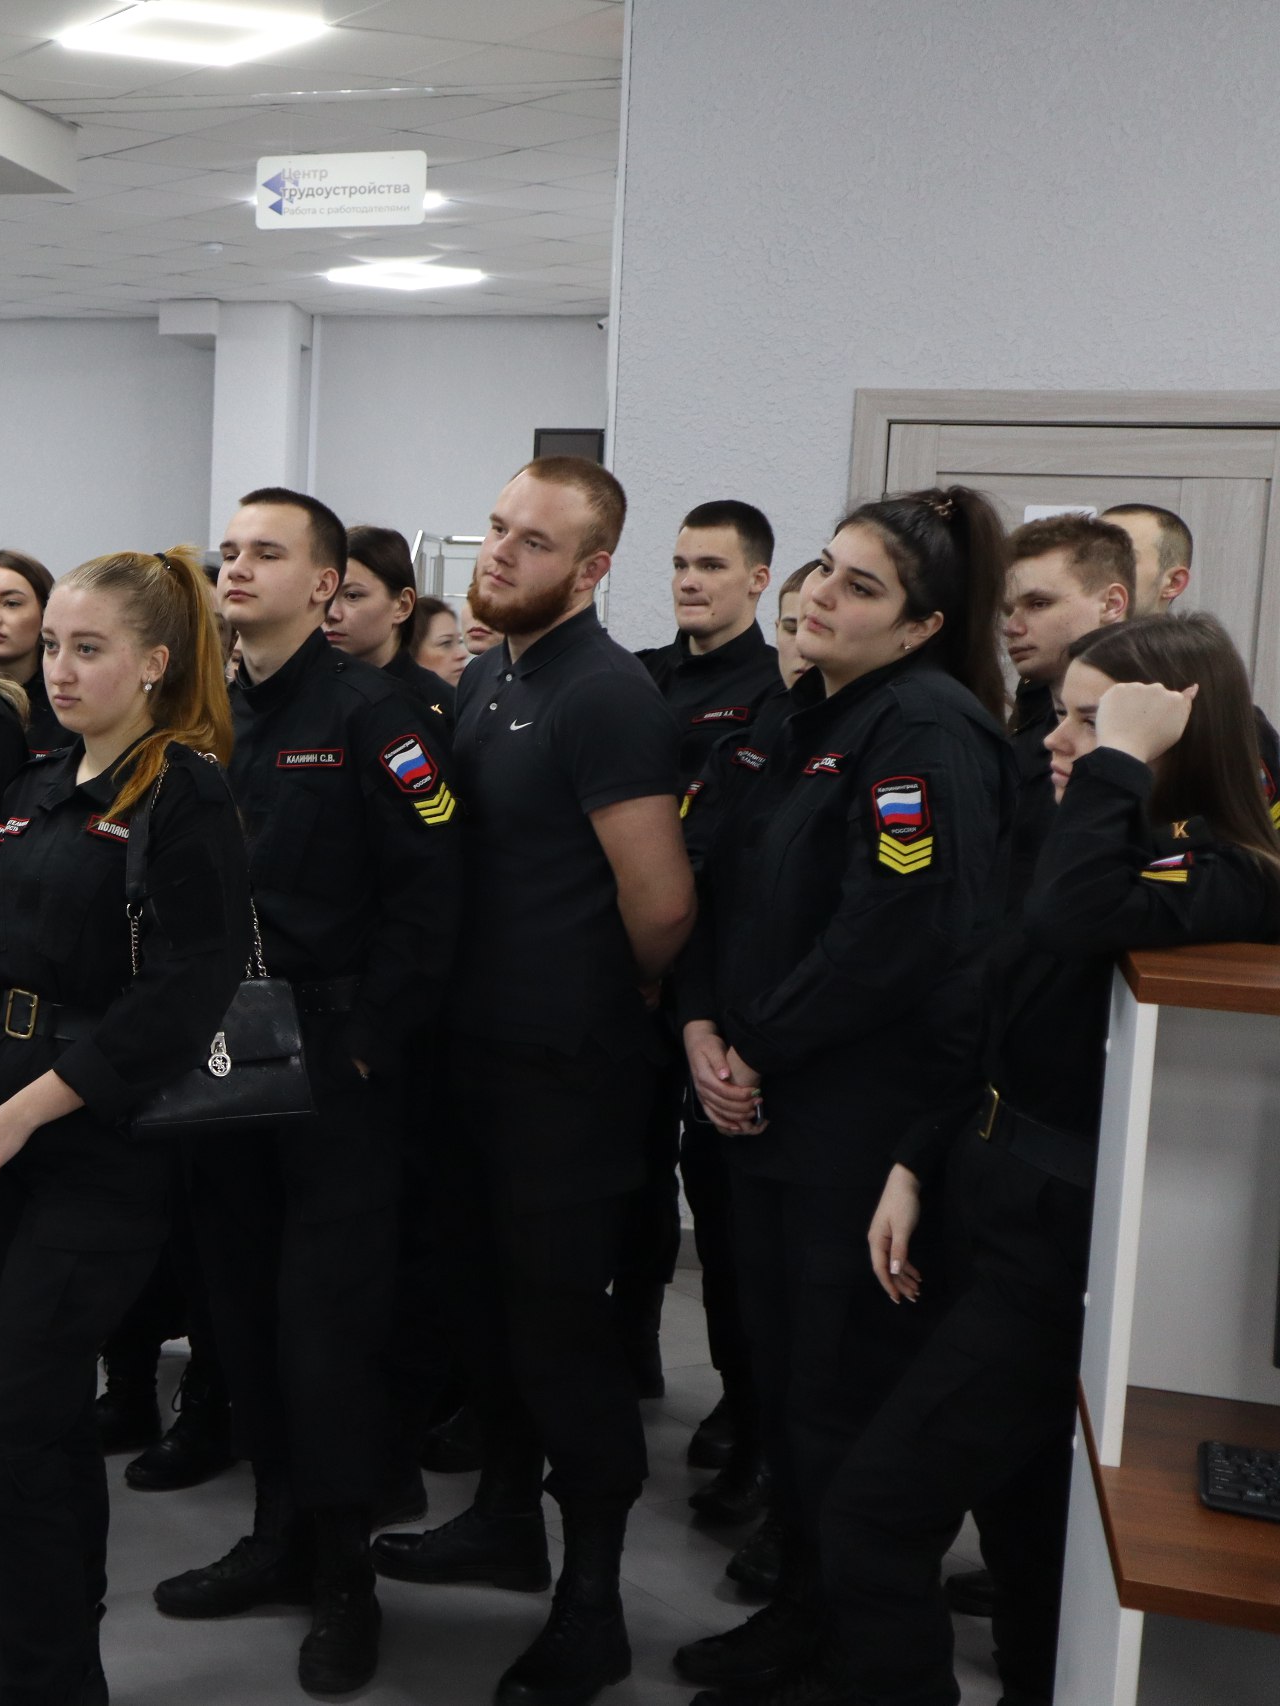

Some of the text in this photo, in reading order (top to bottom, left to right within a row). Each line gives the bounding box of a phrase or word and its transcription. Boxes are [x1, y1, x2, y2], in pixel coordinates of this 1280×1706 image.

[281, 168, 329, 182] Центр
[281, 182, 411, 200] трудоустройства
[283, 206, 318, 216] Работа
[327, 203, 411, 215] работодателями
[286, 754, 336, 764] КАЛИНИН С.В.
[877, 783, 919, 793] Калининград
